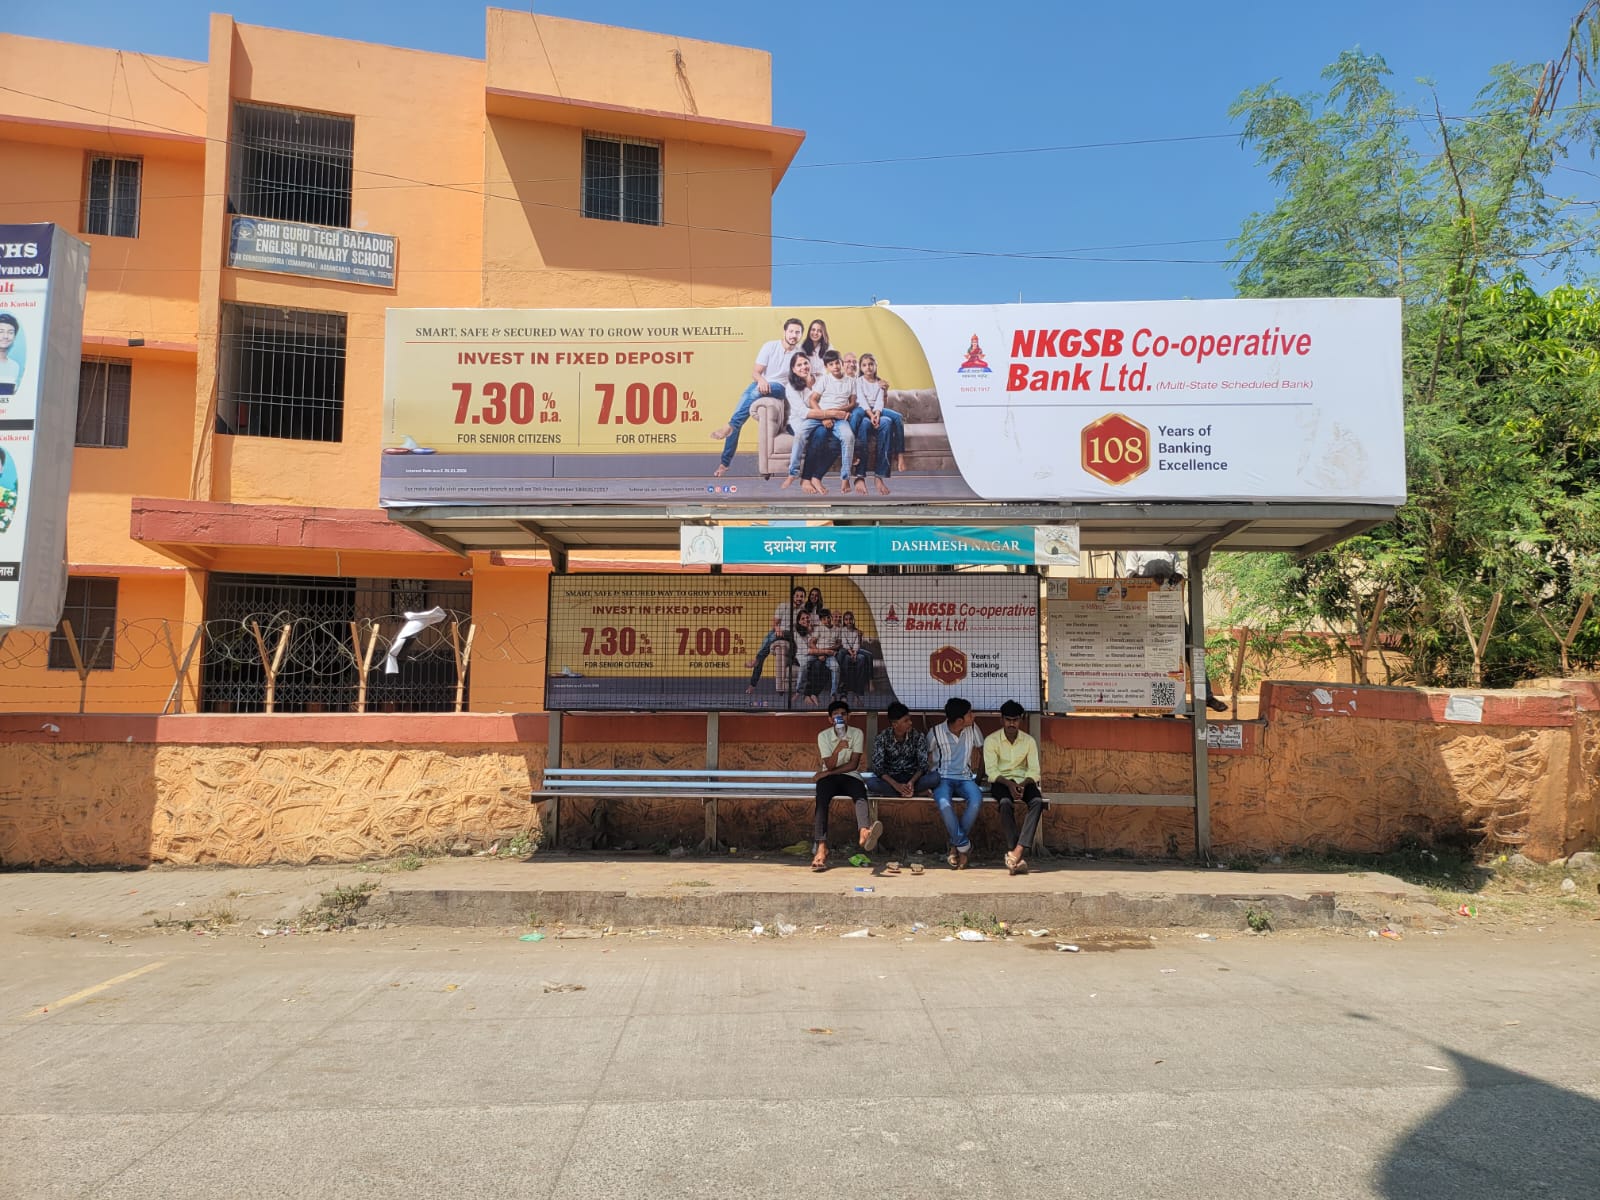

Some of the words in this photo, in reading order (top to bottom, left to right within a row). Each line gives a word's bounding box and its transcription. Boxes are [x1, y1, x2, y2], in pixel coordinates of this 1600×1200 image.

[256, 223, 280, 239] SHRI
[283, 226, 310, 243] GURU
[313, 230, 340, 247] TEGH
[343, 233, 394, 254] BAHADUR
[256, 238, 298, 257] ENGLISH
[301, 243, 349, 263] PRIMARY
[351, 249, 393, 269] SCHOOL
[0, 263, 43, 277] vanced)
[415, 327, 458, 338] SMART,
[460, 327, 489, 337] SAFE
[491, 327, 501, 337] &
[503, 327, 557, 337] SECURED
[559, 327, 586, 337] WAY
[588, 327, 605, 337] TO
[607, 327, 644, 337] GROW
[646, 326, 679, 337] YOUR
[1010, 328, 1125, 358] NKGSB
[1131, 327, 1312, 364] Co-operative
[457, 351, 525, 365] INVEST
[530, 351, 549, 365] IN
[555, 351, 609, 365] FIXED
[615, 351, 694, 365] DEPOSIT
[1005, 363, 1093, 392] Bank
[1099, 362, 1152, 392] Ltd.
[1155, 380, 1218, 391] (Multi-State
[1221, 379, 1279, 390] Scheduled
[1281, 379, 1314, 390] Bank)
[451, 381, 535, 425] 7.30
[541, 391, 556, 410] %
[594, 381, 678, 425] 7.00
[682, 391, 697, 409] %
[539, 410, 562, 424] p.a.
[680, 409, 703, 423] p.a.
[1158, 425, 1195, 437] Years
[1197, 424, 1213, 437] of
[457, 433, 477, 444] FOR
[479, 433, 516, 444] SENIOR
[518, 433, 562, 444] CITIZENS
[616, 433, 636, 444] FOR
[638, 433, 678, 444] OTHERS
[1089, 436, 1143, 464] 108
[1158, 442, 1212, 456] Banking
[1158, 459, 1228, 471] Excellence
[763, 535, 806, 555] दशमेश
[809, 540, 837, 553] नगर
[891, 539, 968, 552] DASHMESH
[970, 540, 1020, 552] NAGAR
[621, 589, 656, 597] SECURED
[657, 589, 673, 597] WAY
[676, 589, 687, 597] TO
[688, 589, 711, 597] GROW
[711, 589, 734, 597] YOUR
[592, 605, 635, 615] INVEST
[639, 605, 651, 615] IN
[655, 605, 690, 615] FIXED
[693, 605, 744, 615] DEPOSIT
[907, 602, 957, 616] NKGSB
[959, 603, 1036, 619] Co-operative
[904, 618, 943, 631] Bank
[945, 618, 969, 632] Ltd.
[581, 626, 636, 656] 7.30
[675, 627, 732, 656] 7.00
[970, 652, 991, 660] Years
[992, 652, 1000, 660] of
[584, 661, 598, 669] FOR
[600, 661, 624, 669] SENIOR
[624, 661, 654, 669] CITIZENS
[689, 661, 703, 669] FOR
[704, 661, 730, 669] OTHERS
[935, 658, 964, 674] 108
[970, 662, 1000, 670] Banking
